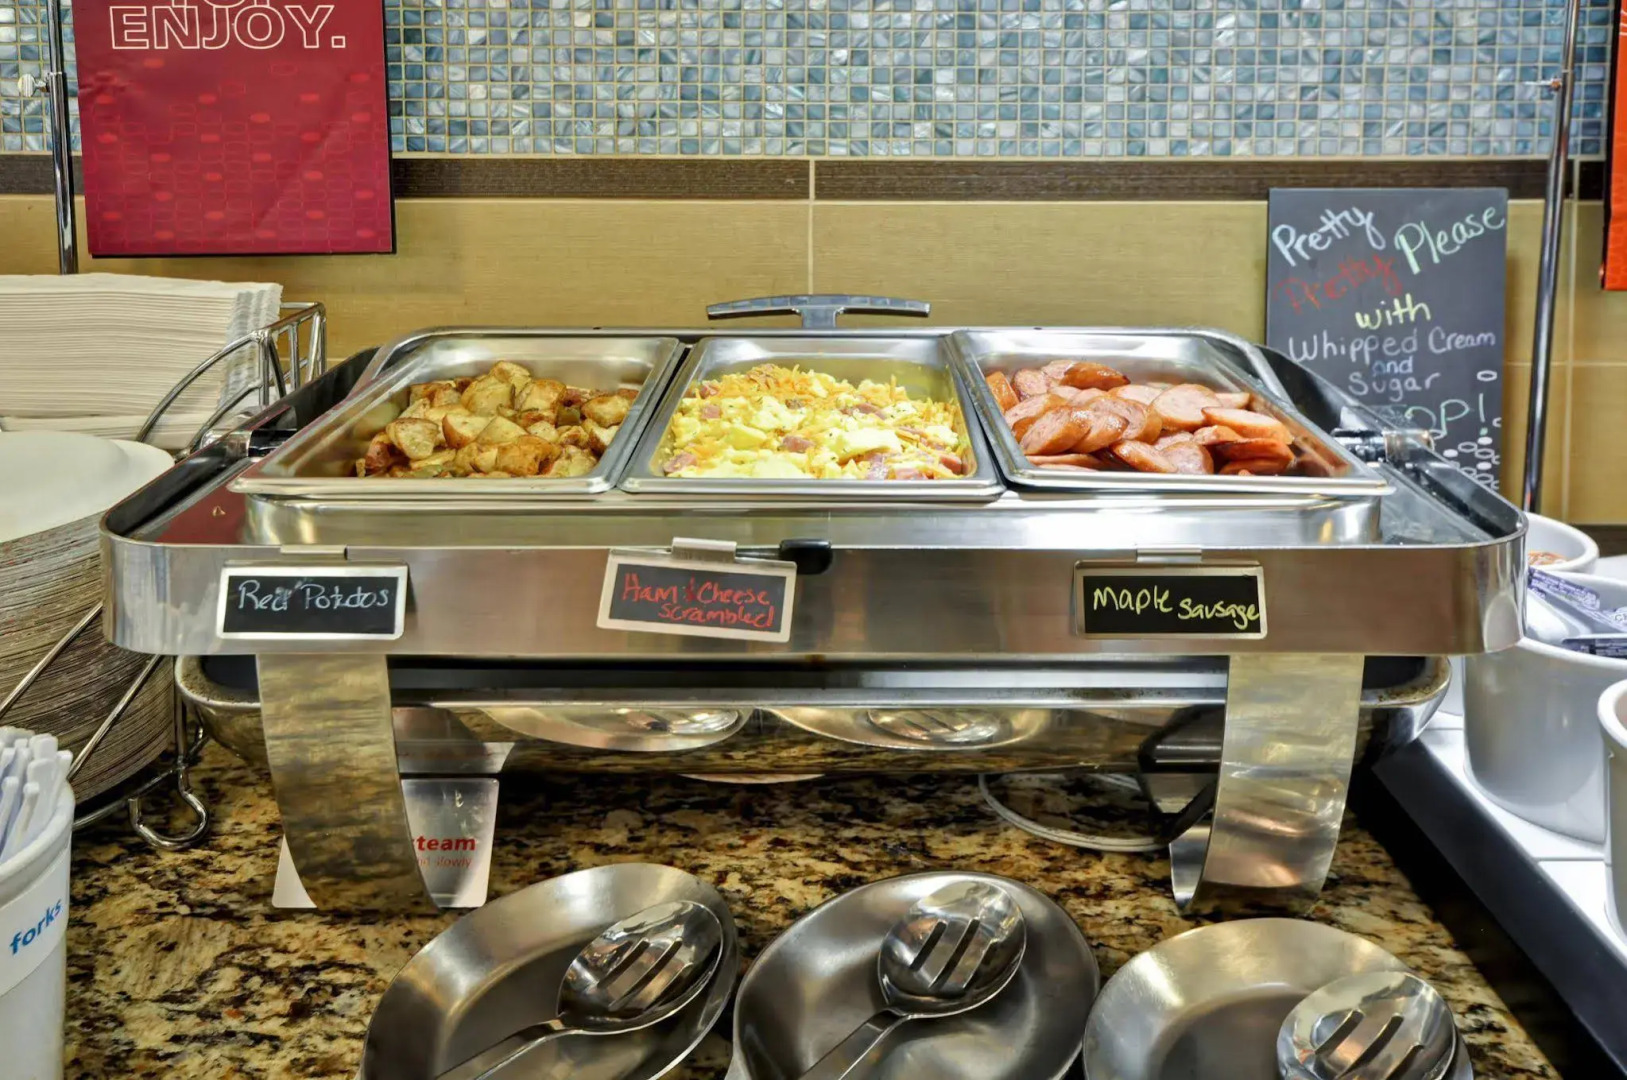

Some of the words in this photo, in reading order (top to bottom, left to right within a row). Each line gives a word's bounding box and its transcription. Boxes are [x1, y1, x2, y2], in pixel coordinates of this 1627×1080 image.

[109, 5, 346, 49] ENJOY.
[1271, 207, 1386, 267] Pretty
[1394, 206, 1505, 275] Please
[1273, 254, 1403, 315] Pretty
[1355, 293, 1431, 330] with
[1288, 329, 1418, 365] Whipped
[1427, 326, 1496, 354] Cream
[1371, 355, 1414, 375] and
[238, 579, 289, 612] Red
[622, 573, 678, 604] Ham
[697, 581, 771, 606] Cheese
[1093, 585, 1173, 615] Maple
[412, 836, 476, 851] team
[10, 899, 62, 955] forks
